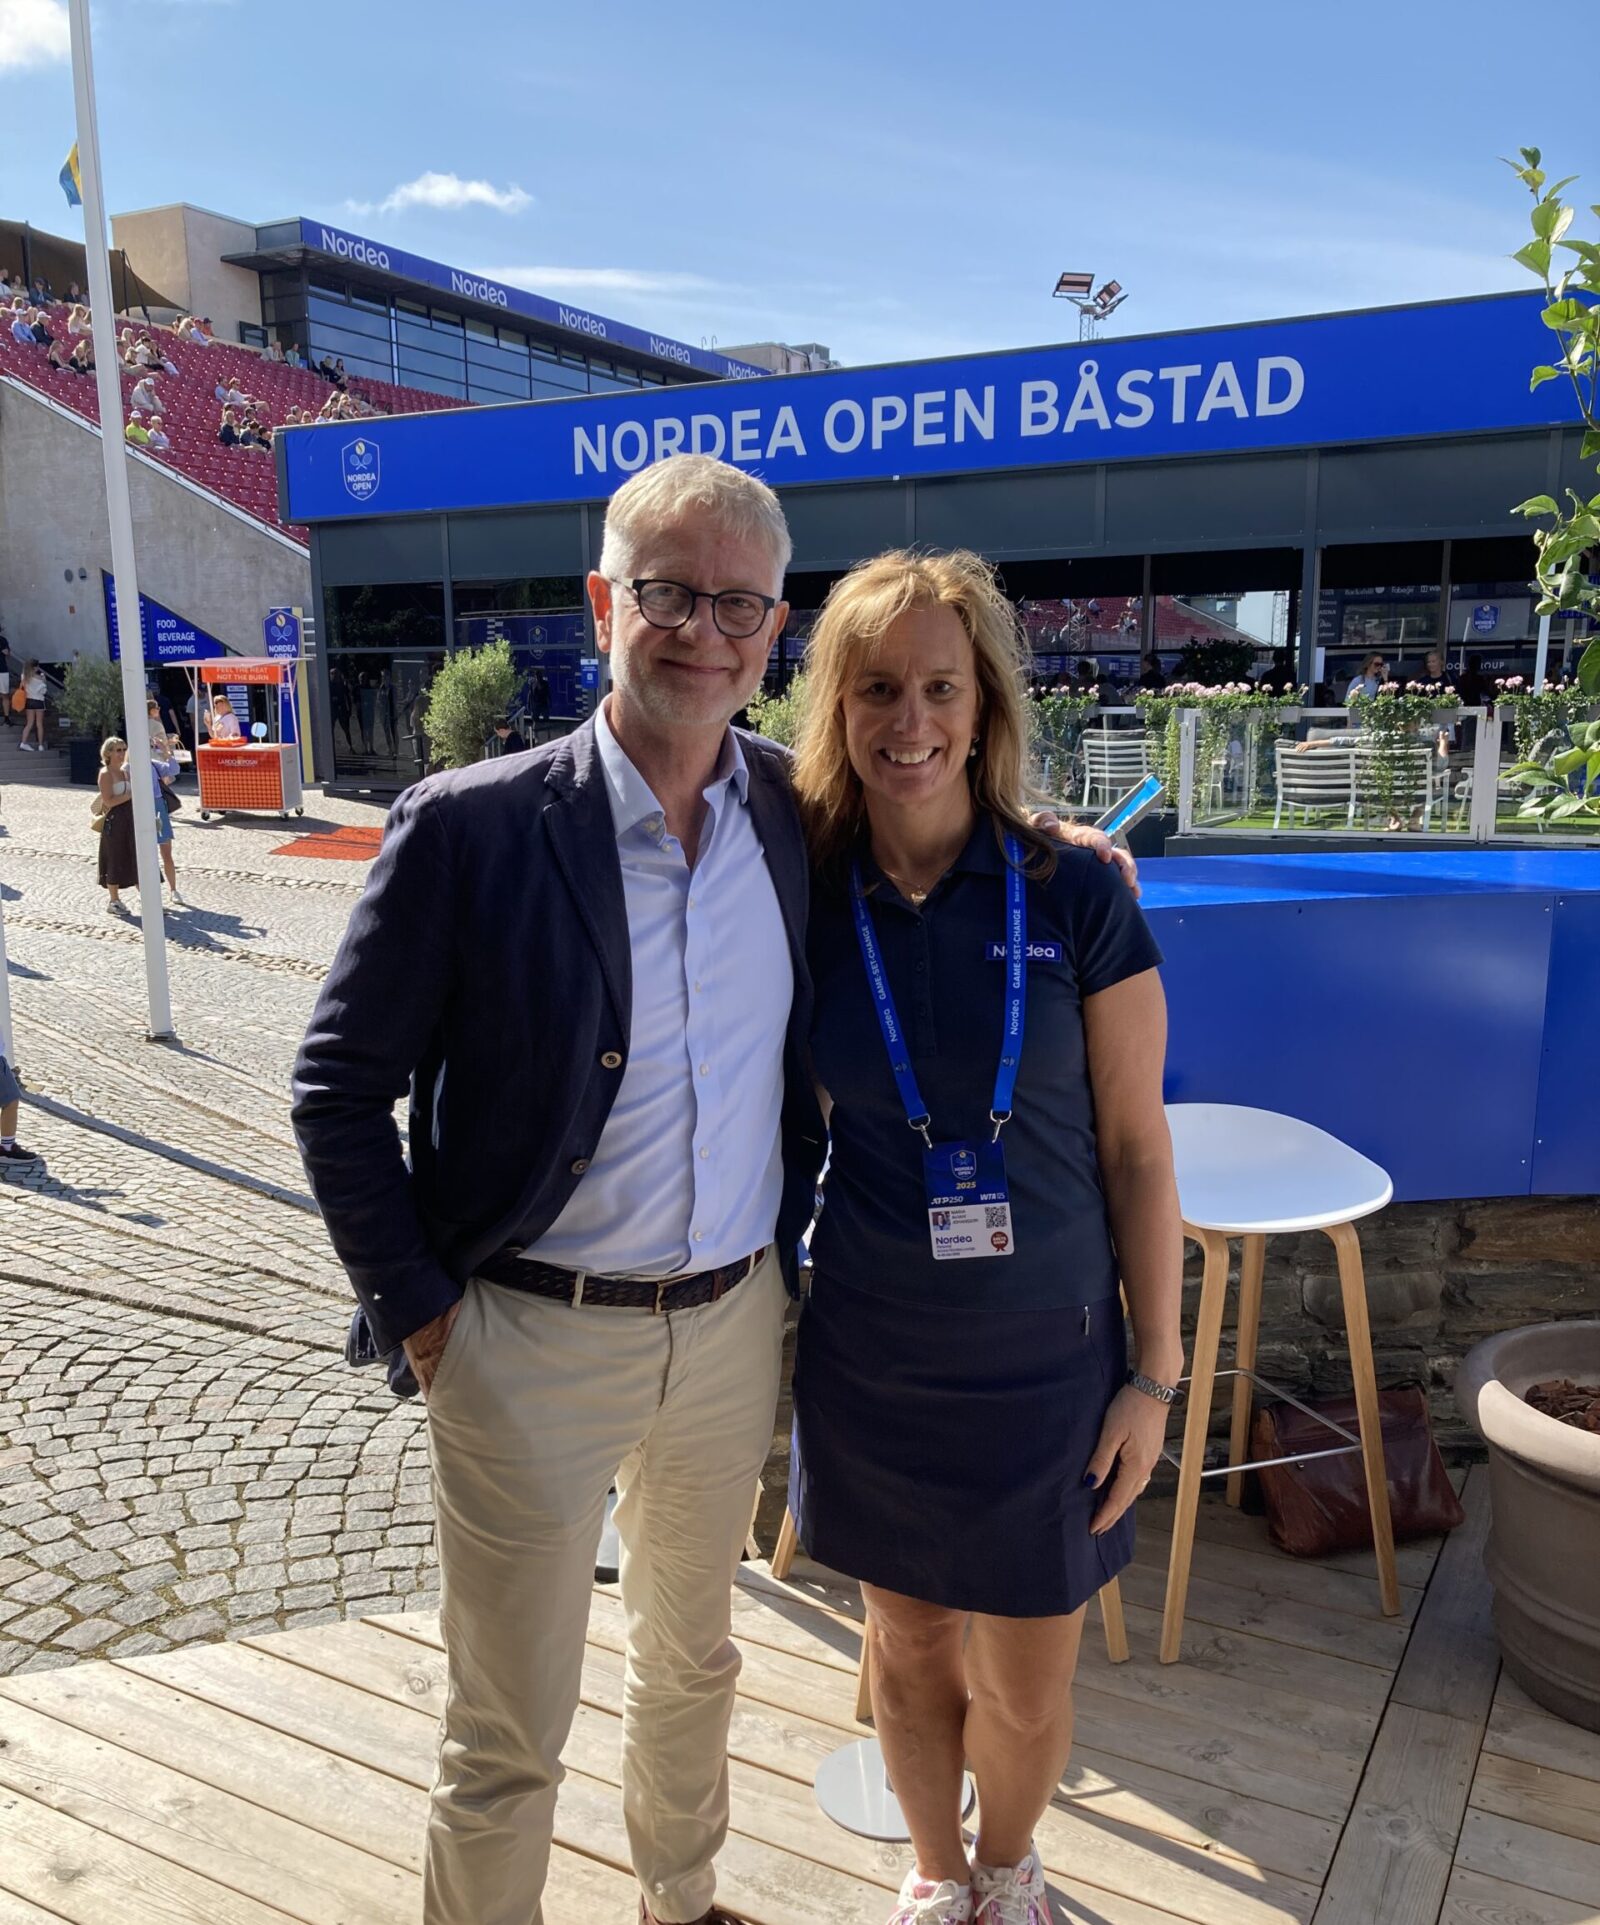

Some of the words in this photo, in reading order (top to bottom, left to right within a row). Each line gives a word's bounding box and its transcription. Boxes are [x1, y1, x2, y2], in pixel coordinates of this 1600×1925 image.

[321, 228, 390, 270] Nordea
[451, 271, 507, 307] Nordea
[559, 306, 607, 337] Nordea
[650, 336, 690, 364] Nordea
[728, 361, 761, 379] Norde
[573, 405, 807, 475] NORDEA
[823, 385, 995, 453] OPEN
[1020, 355, 1305, 437] BÅSTAD
[347, 473, 376, 483] NORDEA
[352, 482, 372, 491] OPEN
[156, 619, 177, 628] FOOD
[157, 632, 195, 641] BEVERAGE
[158, 645, 195, 655] SHOPPING
[268, 644, 297, 653] NORDEA
[1446, 662, 1467, 670] OOL
[993, 944, 1055, 958] Ndea
[1012, 908, 1021, 989] GAME-SET-CHANGE
[861, 924, 887, 1001] GAME-SET-CHANGE
[1010, 999, 1020, 1035] Nordea
[883, 1008, 898, 1043] Nordea
[955, 1182, 976, 1190] 2025
[935, 1235, 972, 1245] Nordea
